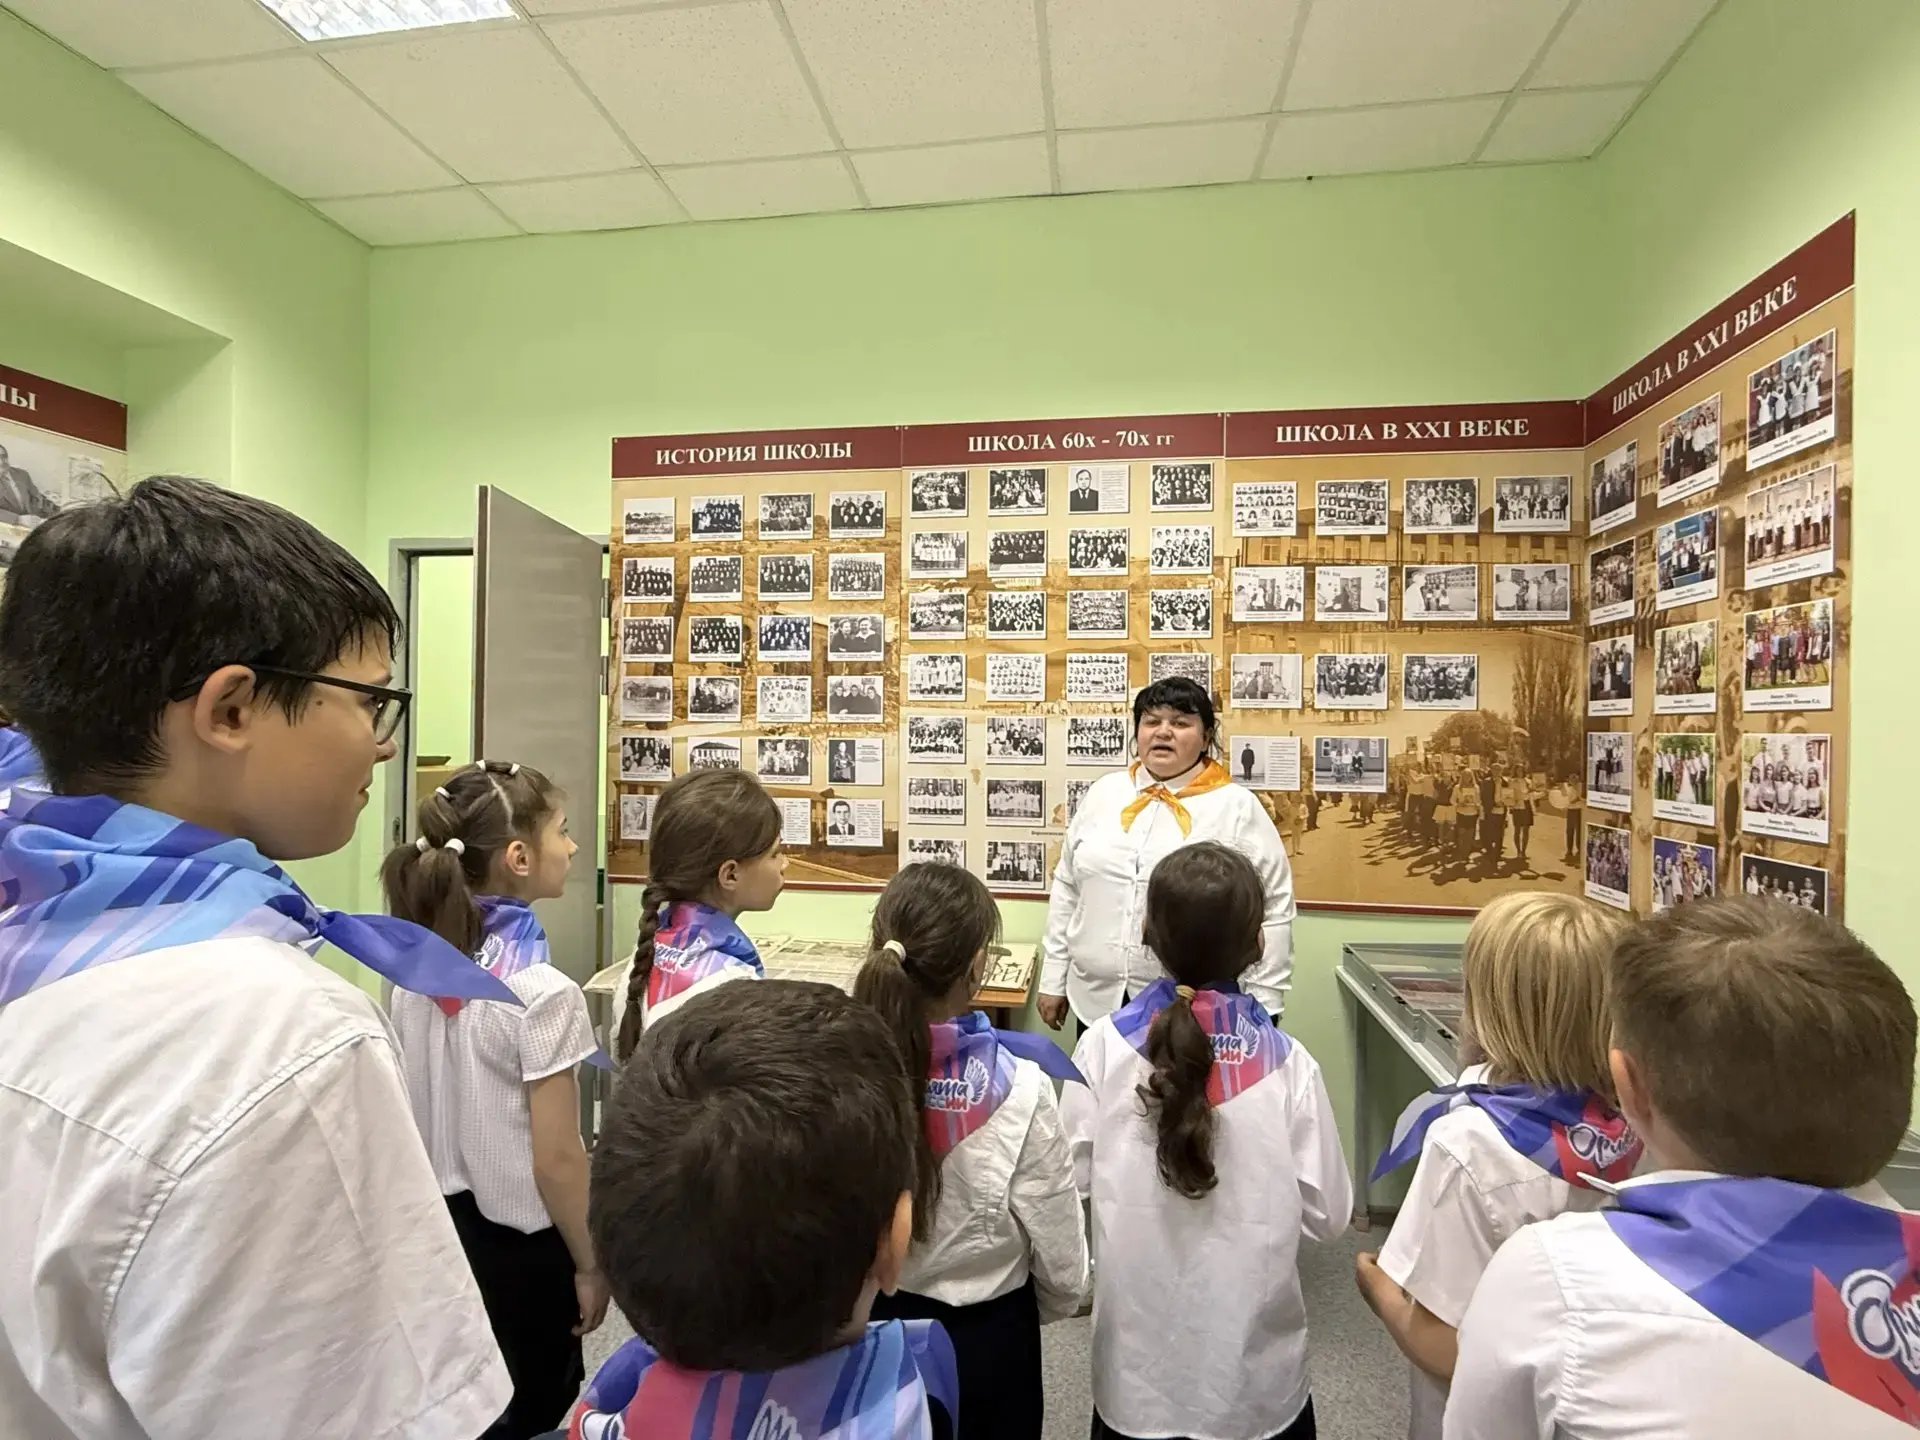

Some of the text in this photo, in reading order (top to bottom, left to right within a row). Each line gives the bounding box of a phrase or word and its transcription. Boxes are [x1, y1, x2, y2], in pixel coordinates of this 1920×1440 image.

[1612, 276, 1797, 415] ШКОЛА В XXI ВЕКЕ
[968, 434, 1056, 452] ШКОЛА
[1062, 432, 1096, 449] 60х
[1115, 430, 1150, 447] 70х
[1156, 434, 1174, 446] гг
[1275, 418, 1529, 443] ШКОЛА В XXI ВЕКЕ
[656, 442, 853, 465] ИСТОРИЯ ШКОЛЫ
